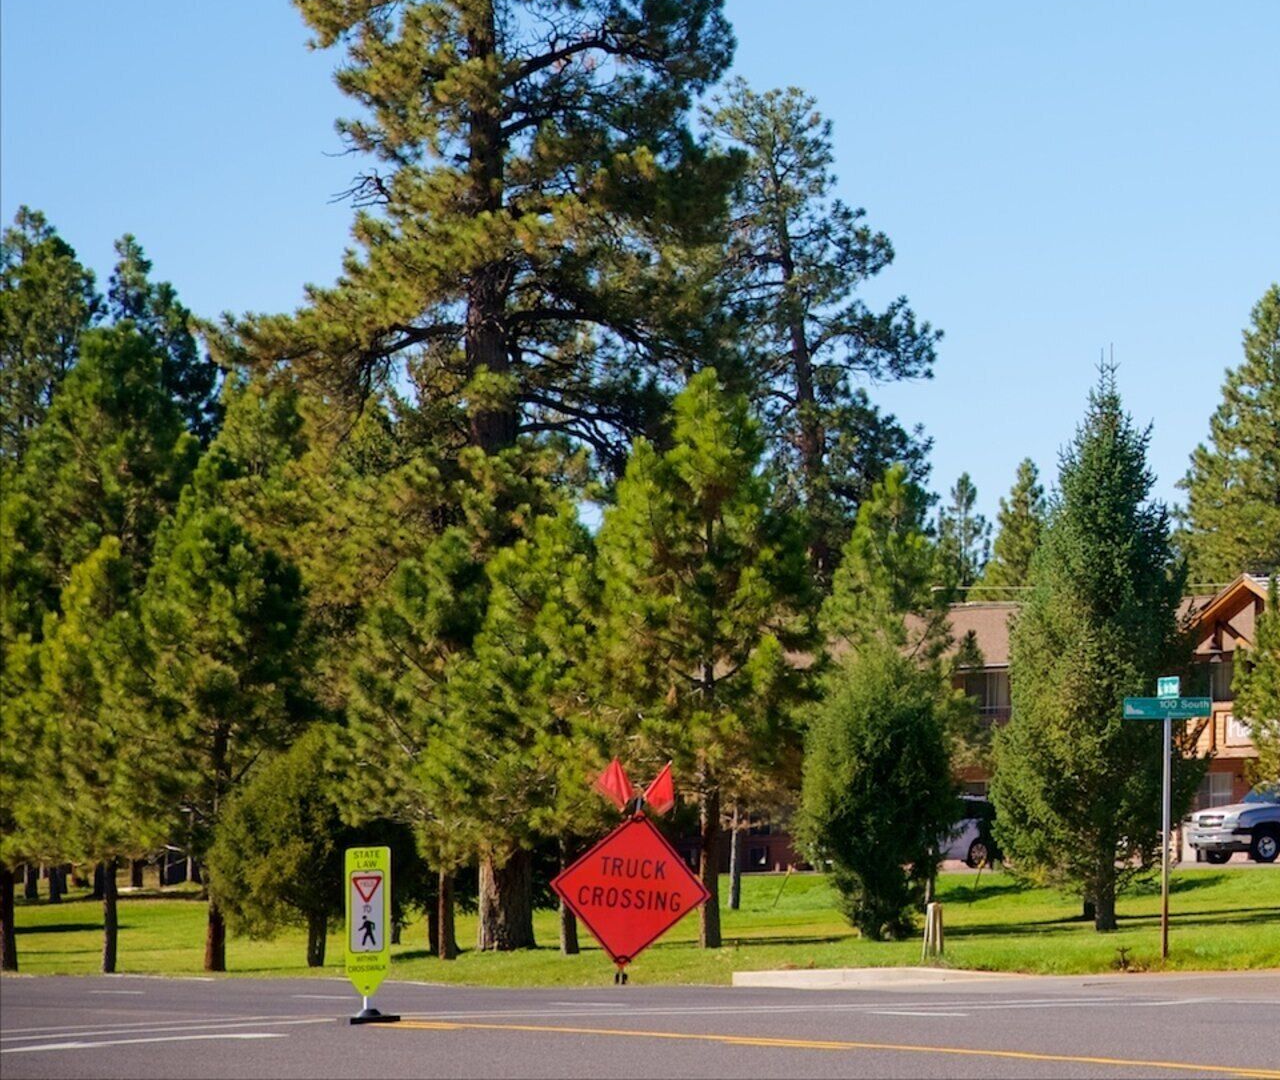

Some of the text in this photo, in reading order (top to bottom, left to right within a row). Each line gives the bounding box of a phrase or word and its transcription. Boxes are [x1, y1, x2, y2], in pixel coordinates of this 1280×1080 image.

[1160, 700, 1210, 709] 100 South
[353, 850, 380, 859] STATE
[356, 860, 377, 869] LAW
[601, 856, 666, 881] TRUCK
[578, 885, 682, 913] CROSSING
[362, 904, 372, 914] TO
